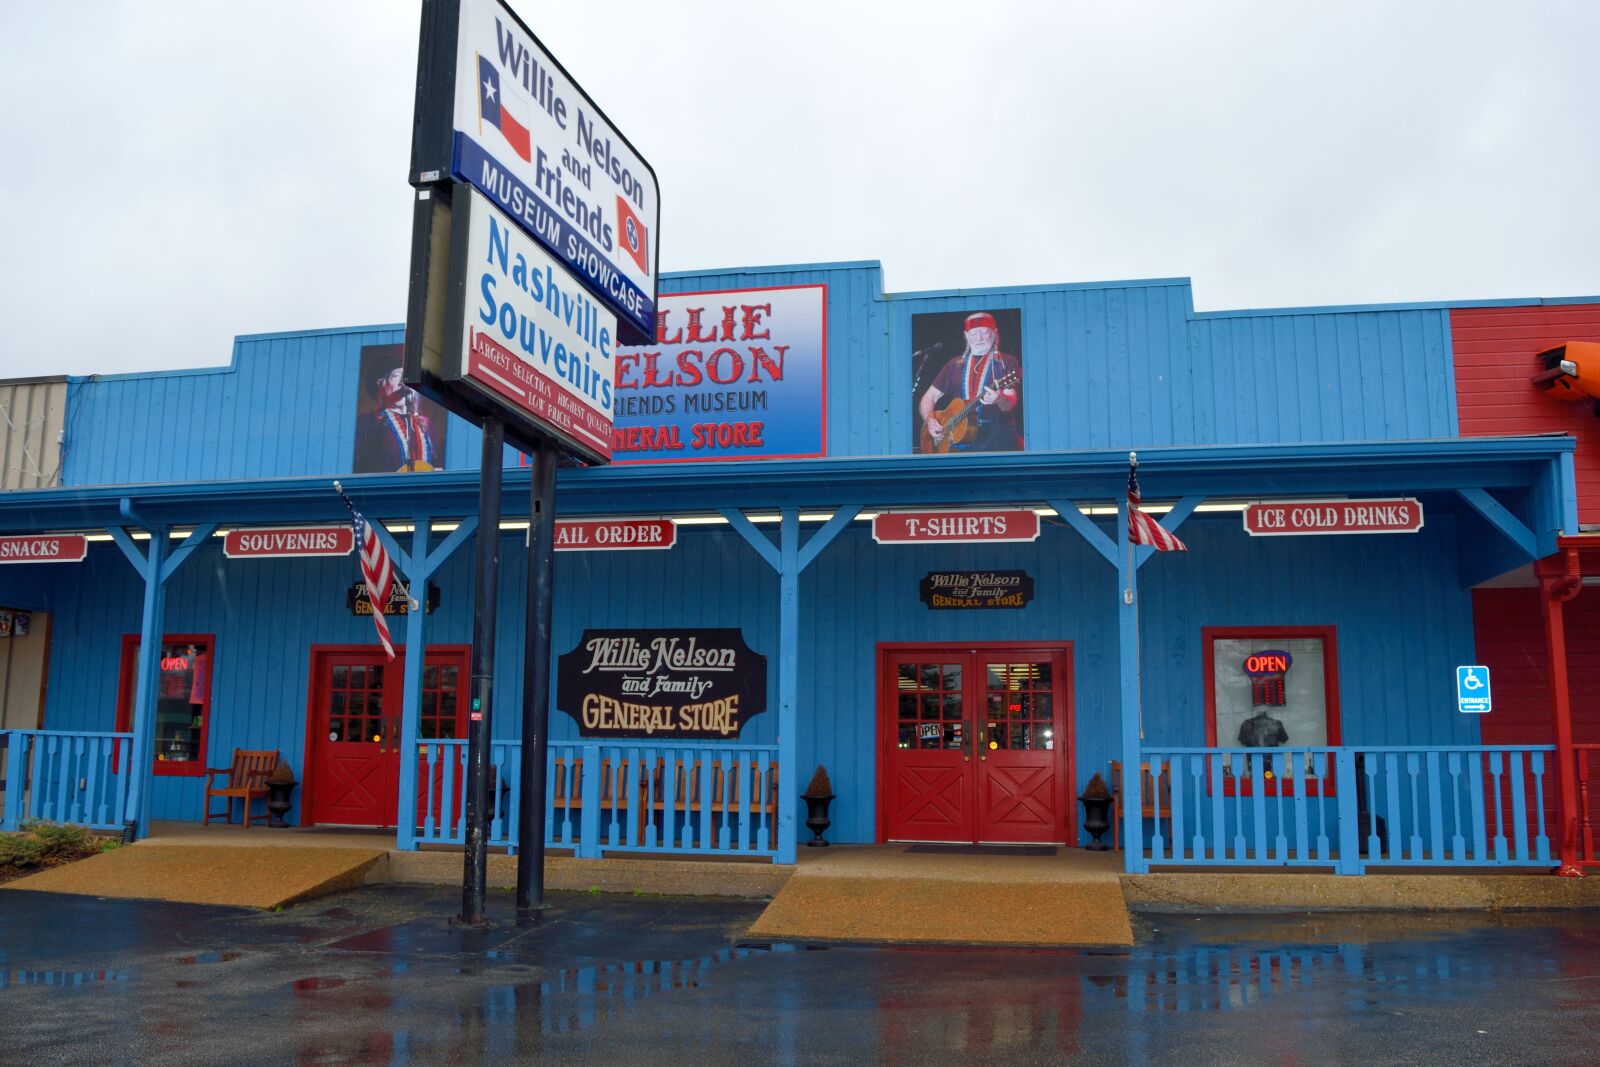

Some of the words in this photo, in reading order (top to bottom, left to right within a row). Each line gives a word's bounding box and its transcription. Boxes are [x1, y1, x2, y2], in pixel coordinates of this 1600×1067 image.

[495, 16, 567, 130] Willie
[577, 107, 644, 210] Nelson
[562, 148, 592, 191] and
[534, 145, 613, 253] Friends
[481, 159, 560, 246] MUSEUM
[567, 237, 643, 319] SHOWCASE
[487, 214, 610, 359] Nashville
[657, 303, 771, 345] LLIE
[479, 273, 611, 410] Souvenirs
[616, 345, 789, 389] ELSON
[471, 328, 510, 371] LARGEST
[513, 362, 551, 398] SELECTION
[557, 392, 585, 420] HIGHEST
[587, 412, 612, 438] QUALITY
[528, 391, 546, 411] LOW
[547, 404, 571, 428] PRICES
[684, 390, 768, 413] MUSEUM
[613, 424, 684, 450] NERAL
[691, 421, 765, 448] STORE
[905, 516, 1007, 536] T-SHIRTS
[1257, 509, 1286, 528] ICE
[1291, 507, 1338, 527] COLD
[1344, 506, 1410, 526] DRINKS
[239, 532, 338, 551] SOUVENIRS
[554, 527, 589, 544] AIL
[595, 524, 663, 544] ORDER
[0, 540, 60, 557] SNACKS
[930, 574, 968, 589] Willie
[968, 573, 1020, 589] Nelson
[968, 587, 1008, 599] Family
[355, 600, 396, 614] GENAL
[932, 594, 982, 608] GENERAL
[987, 592, 1024, 607] STORE
[161, 657, 189, 671] OPEN
[582, 637, 651, 674] Willie
[647, 637, 736, 674] Nelson
[1247, 656, 1286, 672] OPEN
[621, 674, 651, 697] and
[648, 675, 713, 700] Family
[582, 693, 676, 734] GENERAL
[679, 694, 739, 735] STORE
